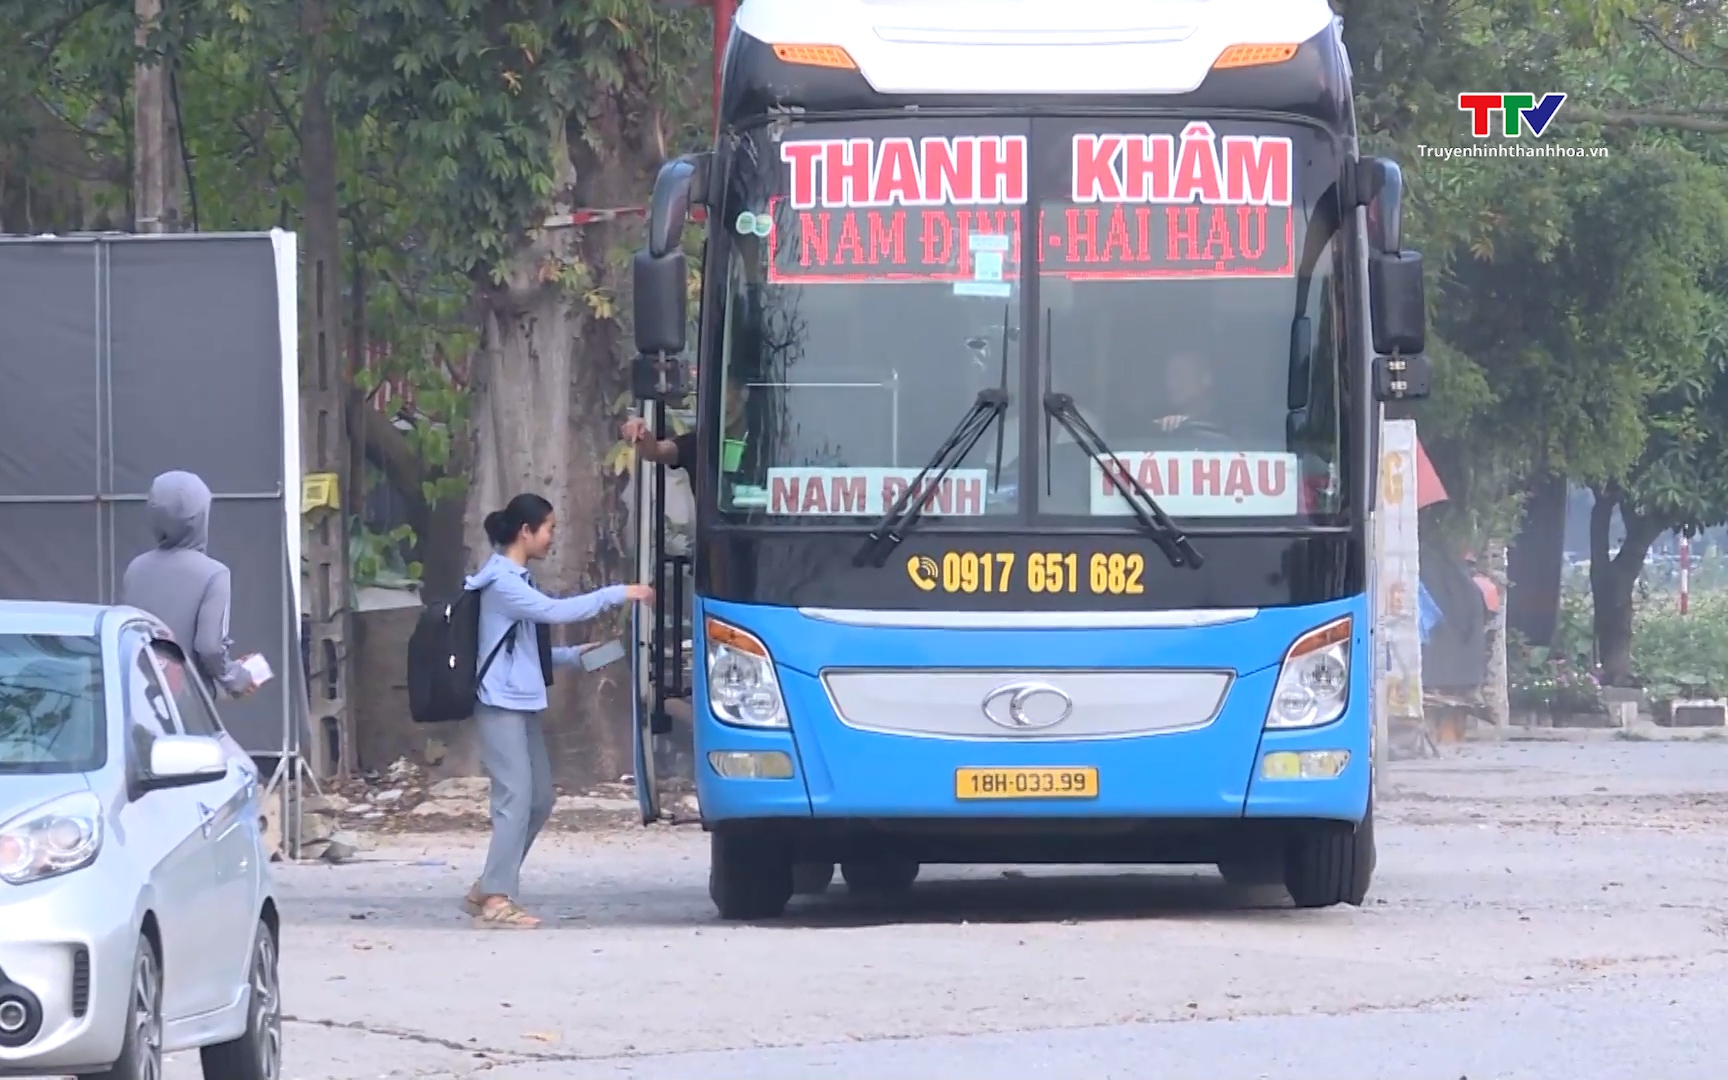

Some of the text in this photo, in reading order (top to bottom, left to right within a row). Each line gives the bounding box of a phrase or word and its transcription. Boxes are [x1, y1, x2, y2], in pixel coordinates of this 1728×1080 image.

[781, 121, 1293, 209] THANH KHÂM
[799, 210, 907, 267] NAM
[771, 476, 867, 513] NAM
[942, 551, 1144, 594] 0917 651 682
[970, 773, 1086, 792] 18H-033.99
